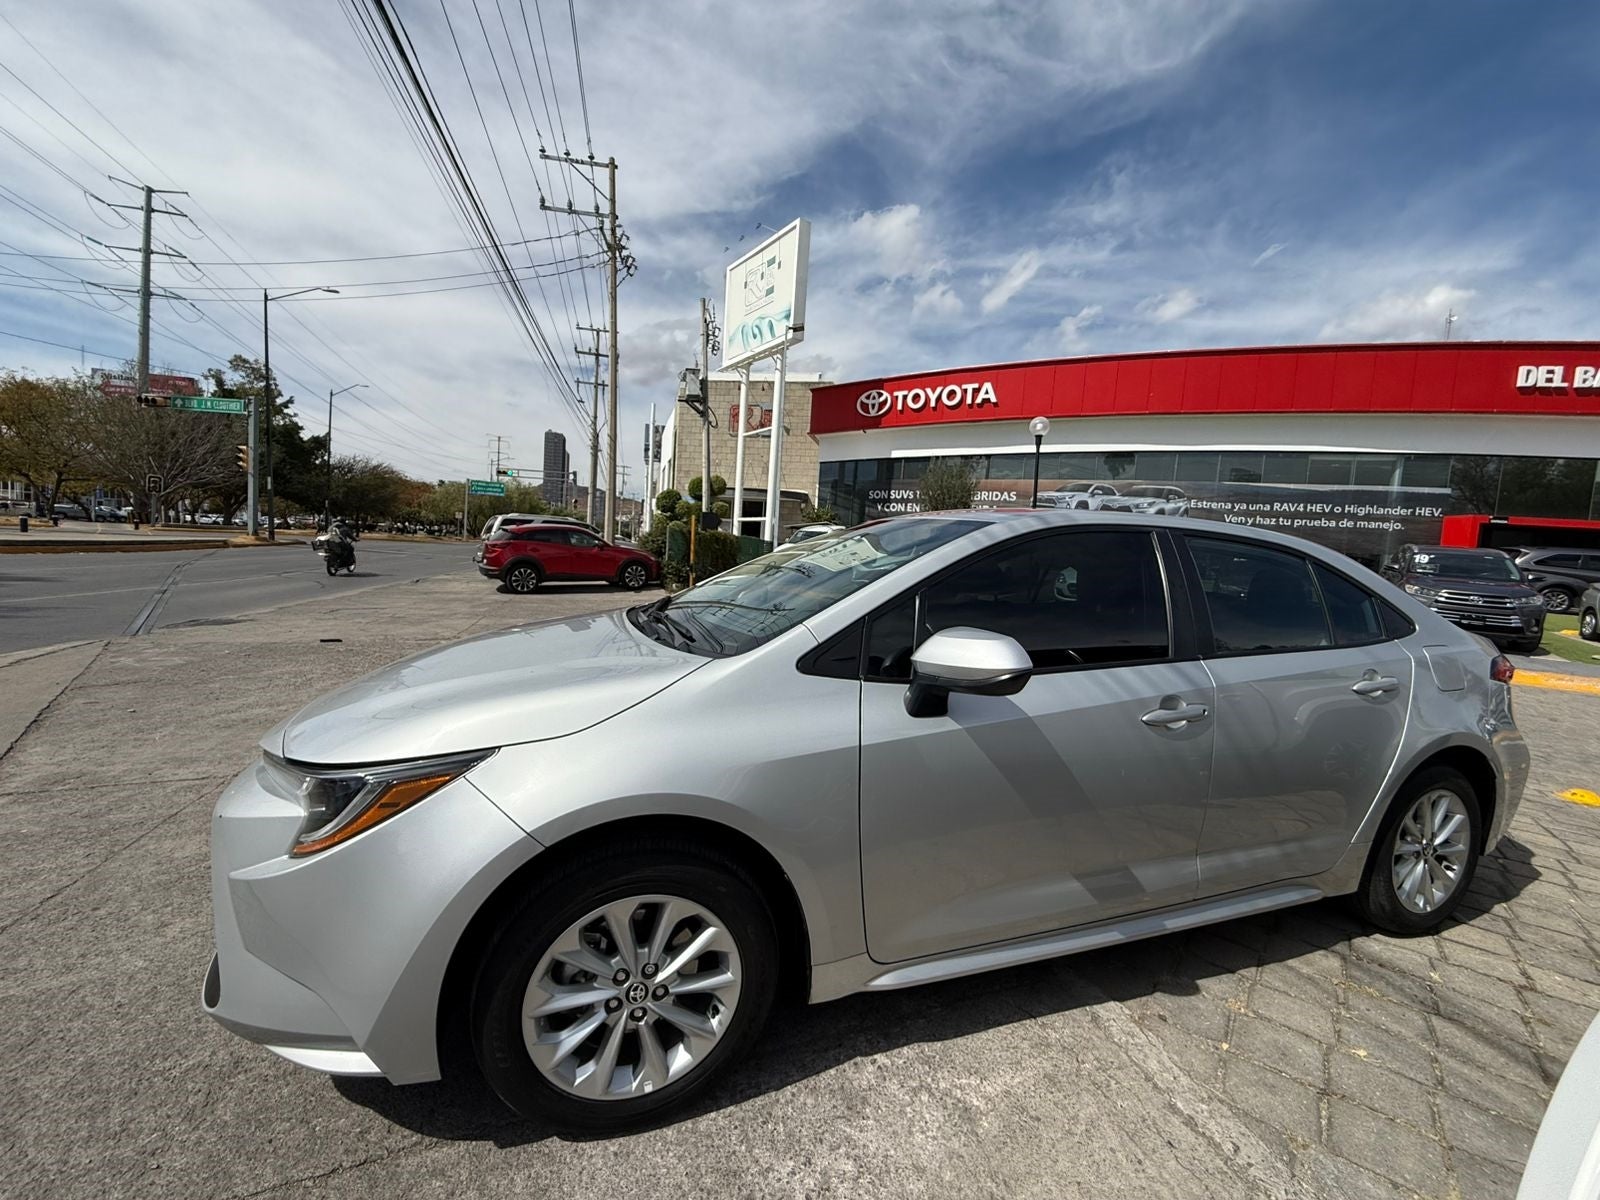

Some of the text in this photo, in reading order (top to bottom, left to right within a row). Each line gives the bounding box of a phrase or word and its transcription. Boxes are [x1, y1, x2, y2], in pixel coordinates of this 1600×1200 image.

[1516, 365, 1569, 387] DEL
[893, 382, 997, 410] TOYOTA
[868, 490, 889, 500] SON
[890, 490, 914, 500] SUVs
[876, 503, 883, 511] Y
[884, 503, 906, 512] CON
[1190, 500, 1232, 509] Estrena
[1234, 503, 1247, 512] ya
[1273, 503, 1304, 512] RAV4
[1306, 504, 1332, 513] HEV
[1344, 504, 1414, 516] Highlander
[1415, 507, 1443, 517] HEV.
[1224, 514, 1405, 531] Ven y haz tu prueba de manejo.
